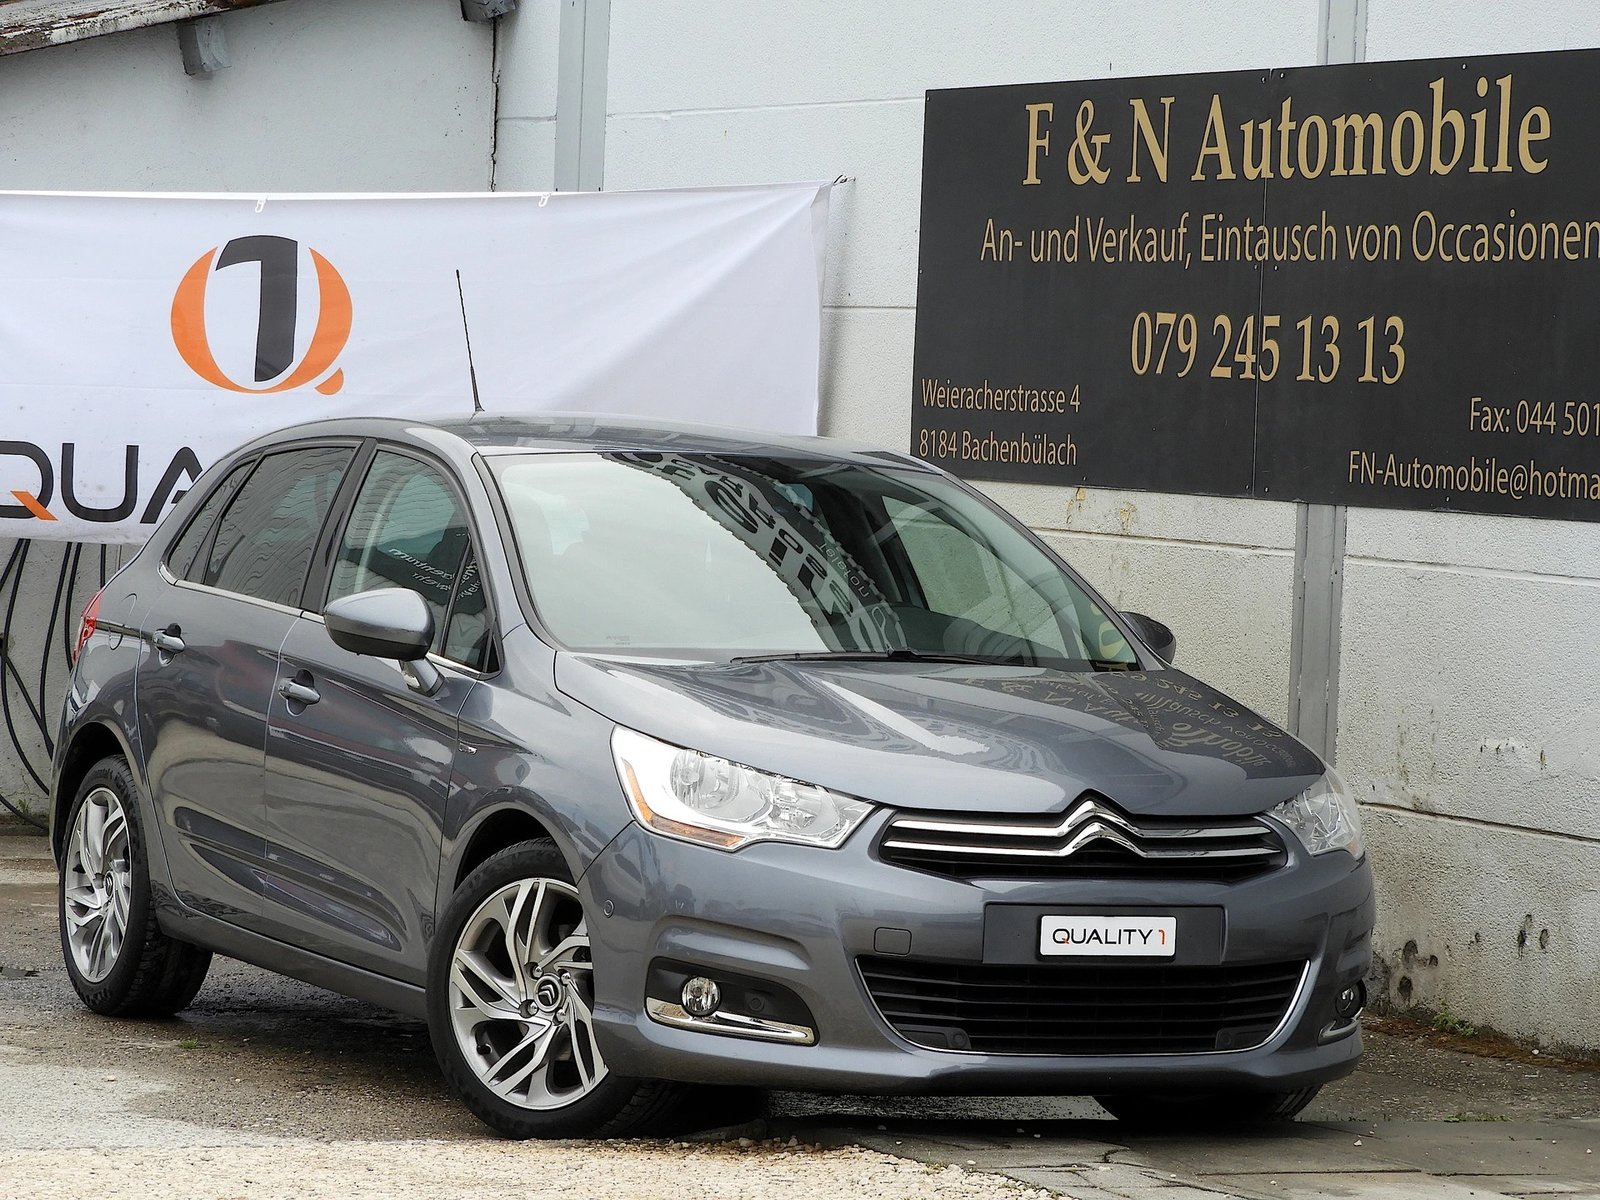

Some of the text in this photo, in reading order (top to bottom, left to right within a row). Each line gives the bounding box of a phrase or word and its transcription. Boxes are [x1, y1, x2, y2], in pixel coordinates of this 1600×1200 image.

[1021, 73, 1551, 185] F & N Automobile
[980, 208, 1600, 269] An- und Verkauf, Eintausch von Occasionen
[1130, 311, 1406, 385] 079 245 13 13
[921, 378, 1081, 414] Weieracherstrasse 4
[1469, 396, 1600, 437] Fax: 044 501
[919, 428, 1077, 466] 8184 Bachenbülach
[1052, 928, 1166, 945] QUALITY 1
